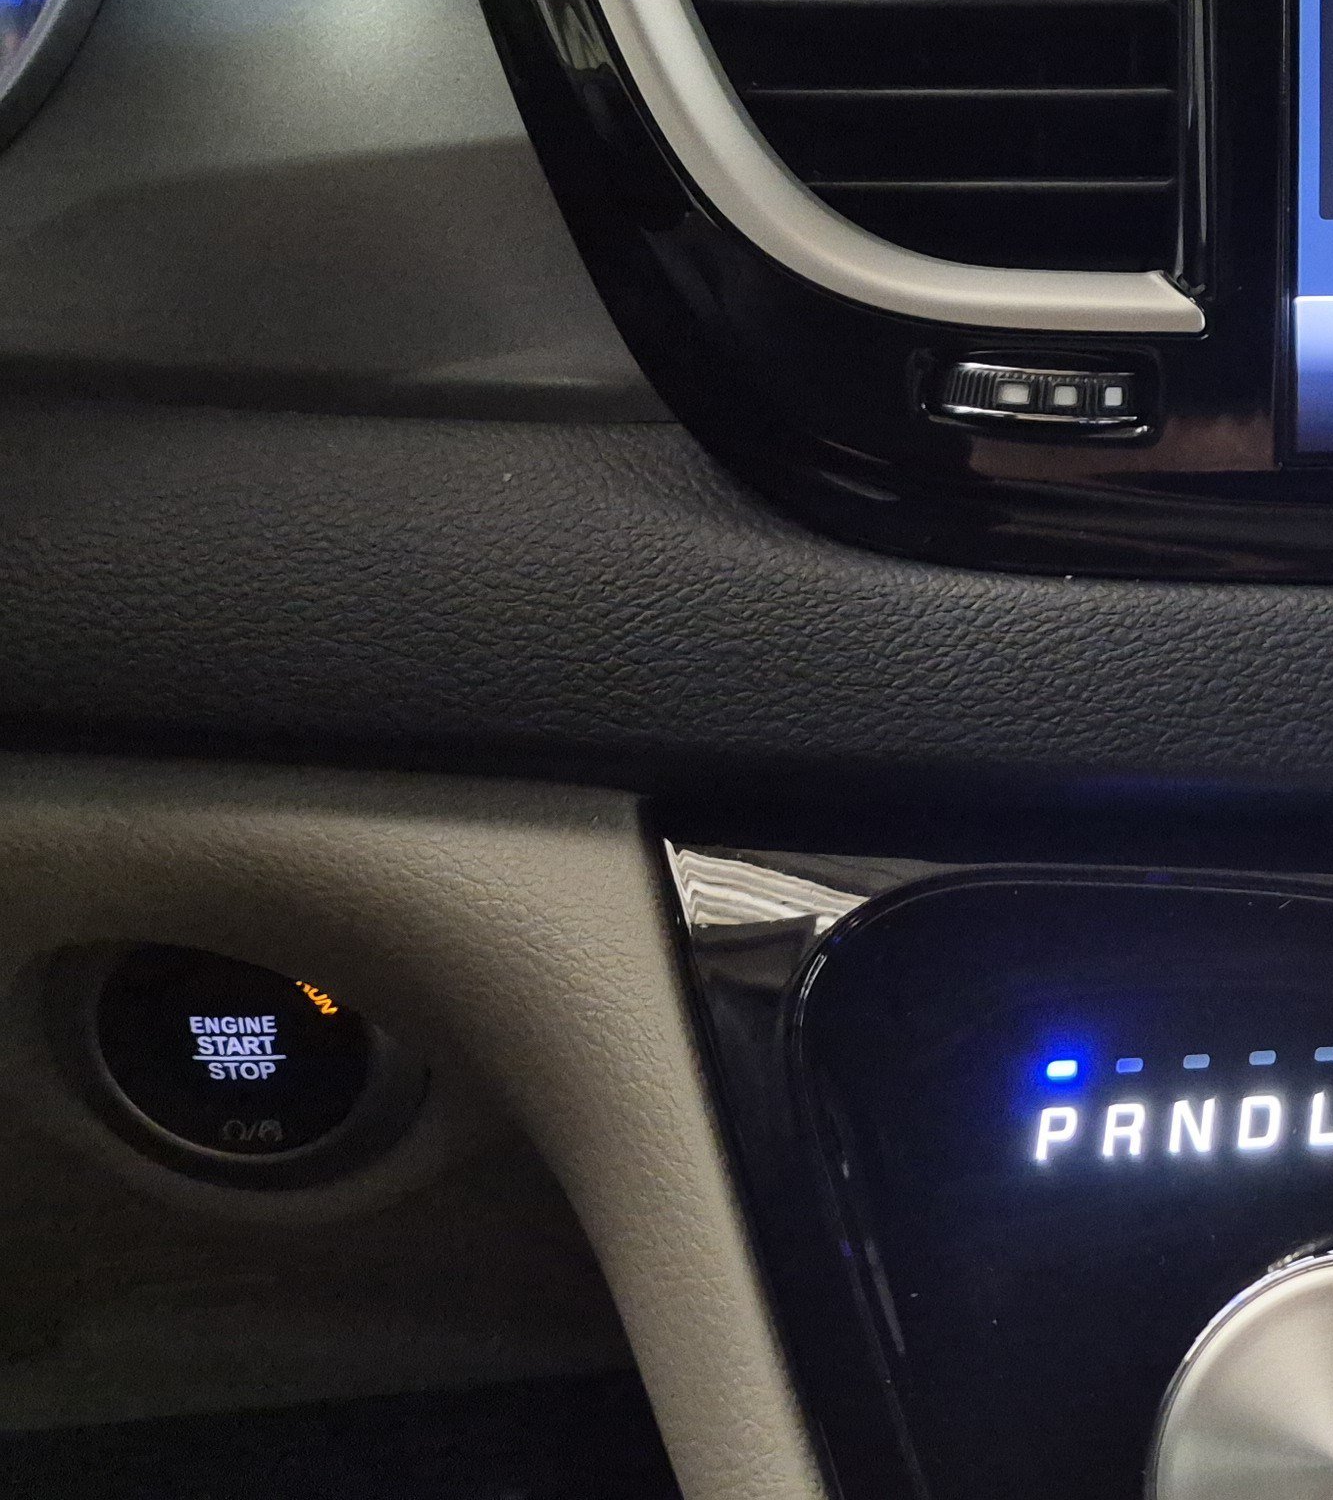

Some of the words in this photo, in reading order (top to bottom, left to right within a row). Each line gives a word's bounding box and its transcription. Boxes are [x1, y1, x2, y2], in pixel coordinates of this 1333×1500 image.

[189, 1015, 278, 1034] ENGINE
[197, 1035, 275, 1056] START
[208, 1061, 276, 1080] STOP
